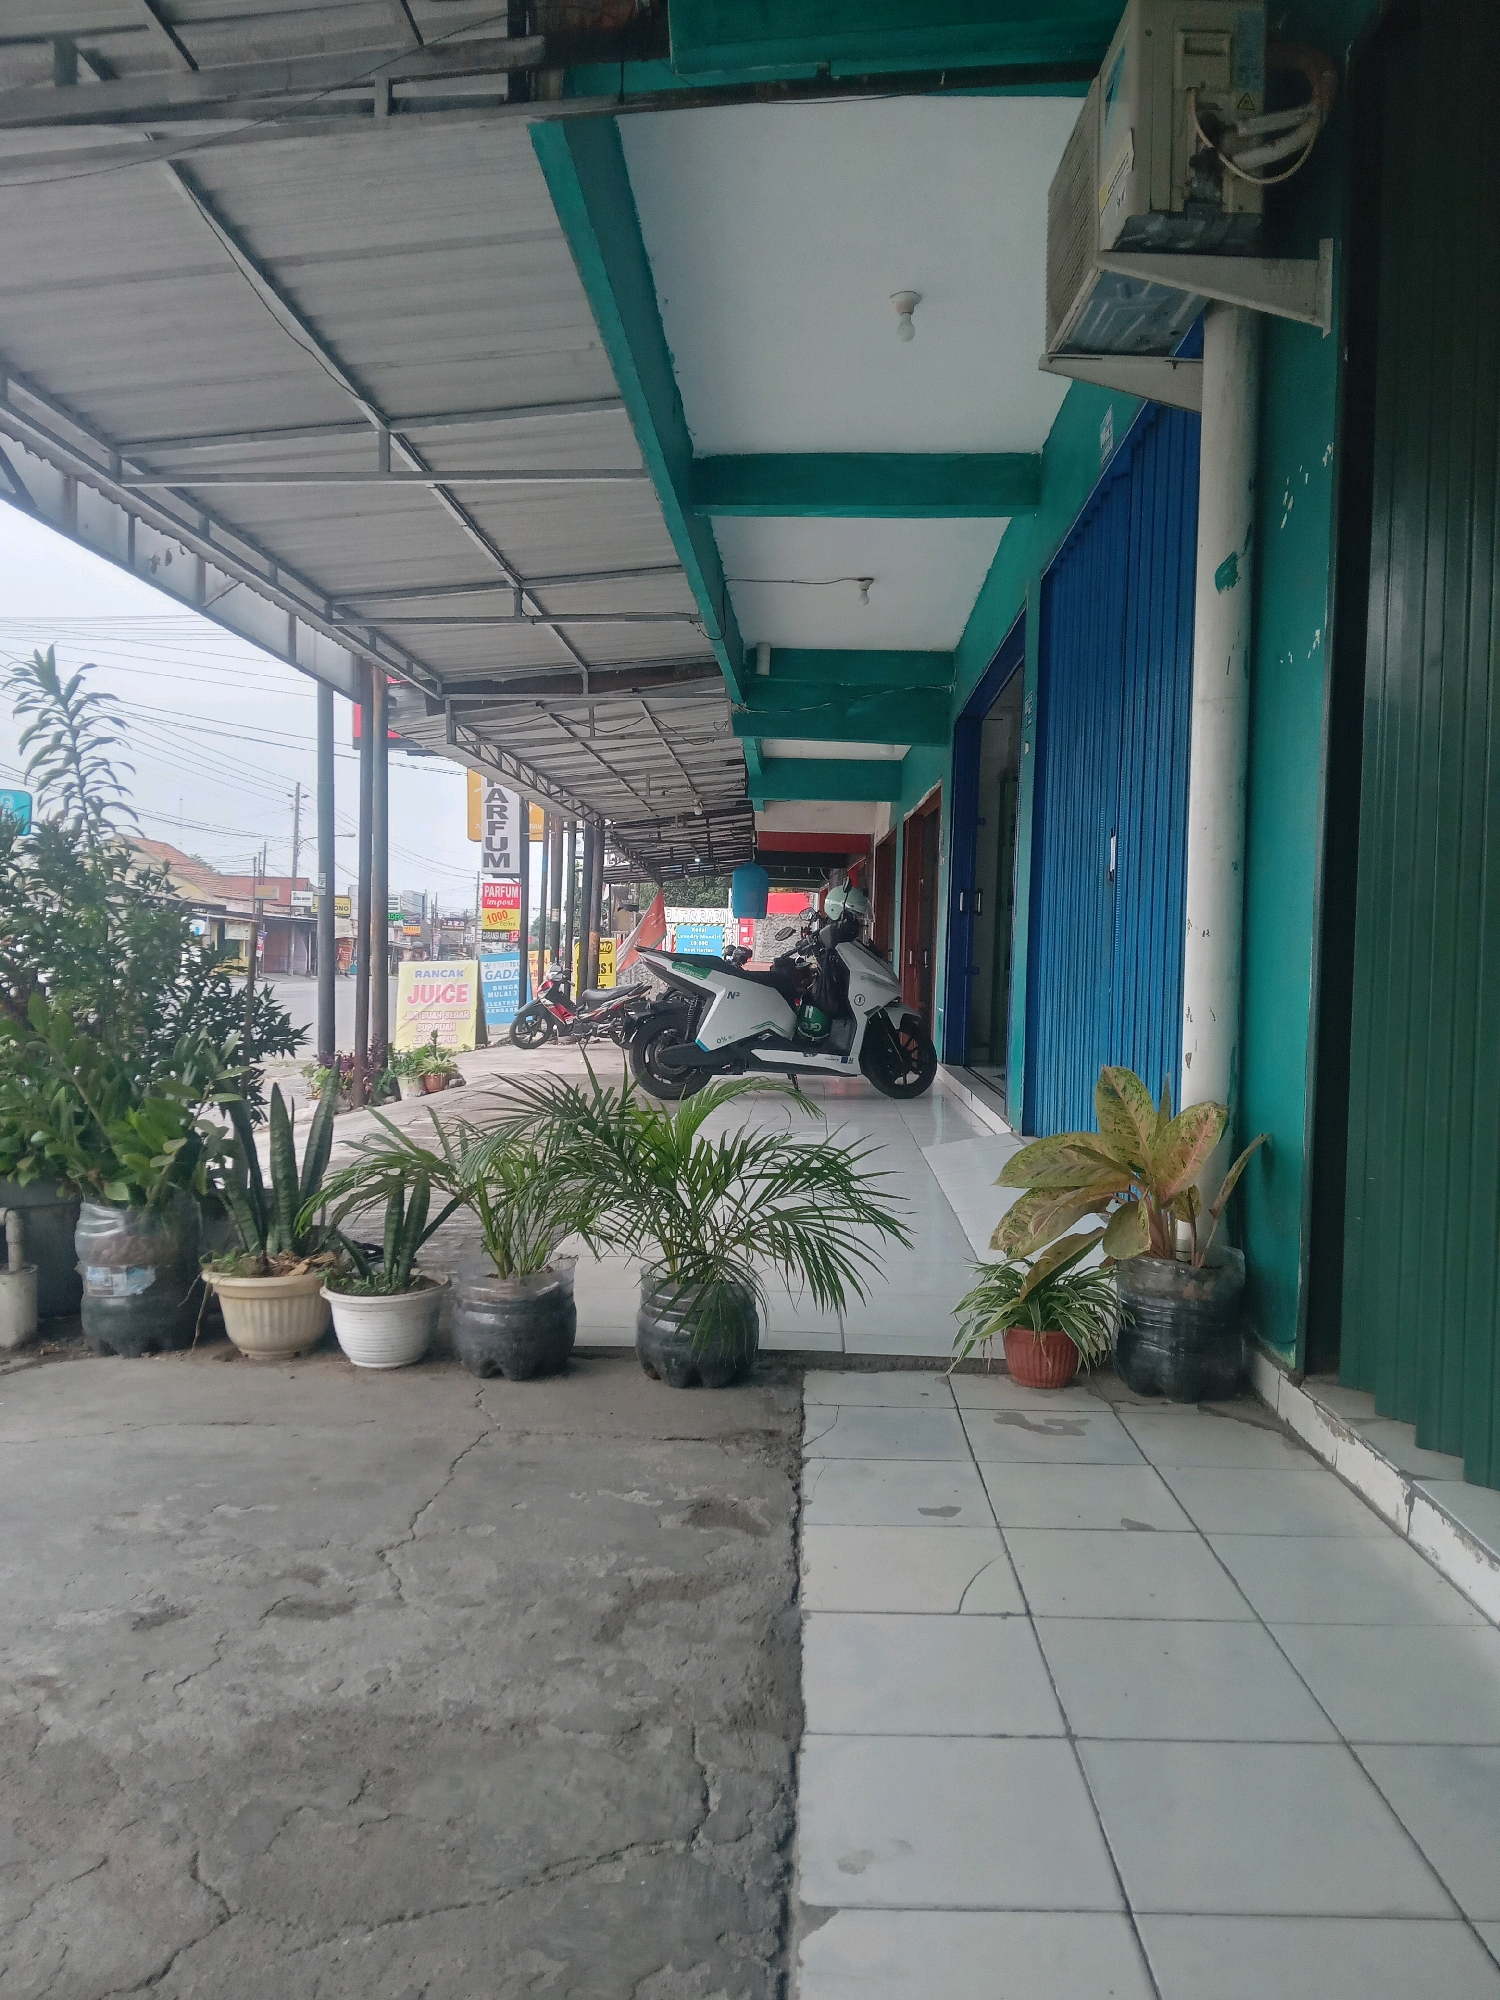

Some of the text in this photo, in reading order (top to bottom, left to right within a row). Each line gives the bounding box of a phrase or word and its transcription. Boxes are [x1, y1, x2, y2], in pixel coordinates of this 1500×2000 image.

[484, 885, 519, 899] PARFUM
[486, 898, 514, 908] import
[486, 909, 509, 924] 1000
[414, 969, 465, 979] RANCAK
[485, 968, 520, 981] GADA
[407, 984, 468, 1004] JUICE
[404, 1010, 421, 1021] JUS
[424, 1034, 458, 1044] CMPUR
